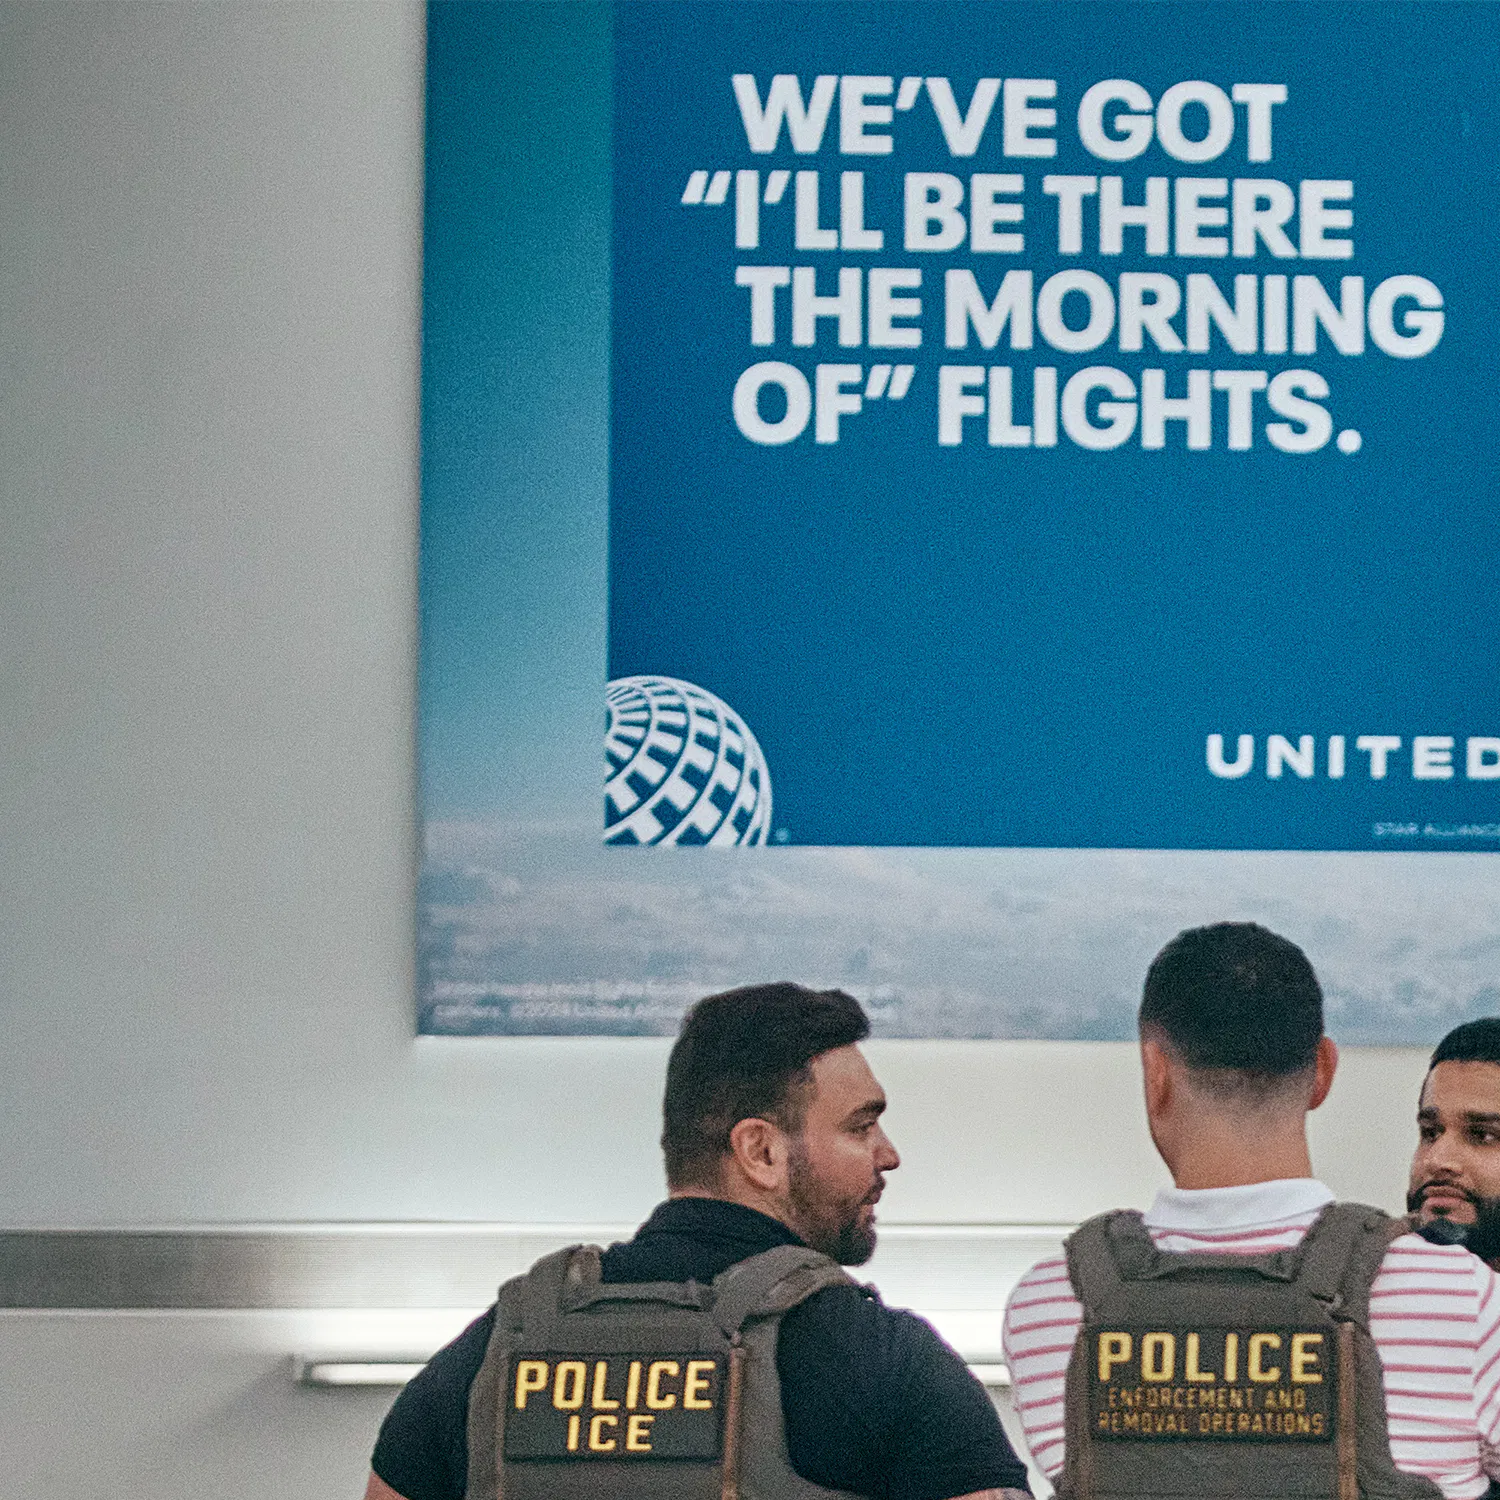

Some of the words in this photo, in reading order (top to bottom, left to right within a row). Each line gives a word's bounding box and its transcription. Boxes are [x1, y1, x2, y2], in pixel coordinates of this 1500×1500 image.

[731, 74, 1058, 159] WE’VE
[1078, 80, 1288, 163] GOT
[680, 169, 883, 251] “I’LL
[904, 173, 1025, 254] BE
[1044, 175, 1354, 259] THERE
[735, 265, 922, 348] THE
[944, 268, 1446, 358] MORNING
[731, 361, 916, 445] OF”
[937, 365, 1363, 454] FLIGHTS.
[1098, 1331, 1324, 1383] POLICE
[514, 1360, 717, 1410] POLICE
[1108, 1387, 1254, 1409] ENFORCEMENT
[1263, 1388, 1307, 1409] AND
[566, 1414, 656, 1451] ICE
[1099, 1411, 1190, 1434] REMOVAL
[1198, 1412, 1325, 1435] OPERATIONS
